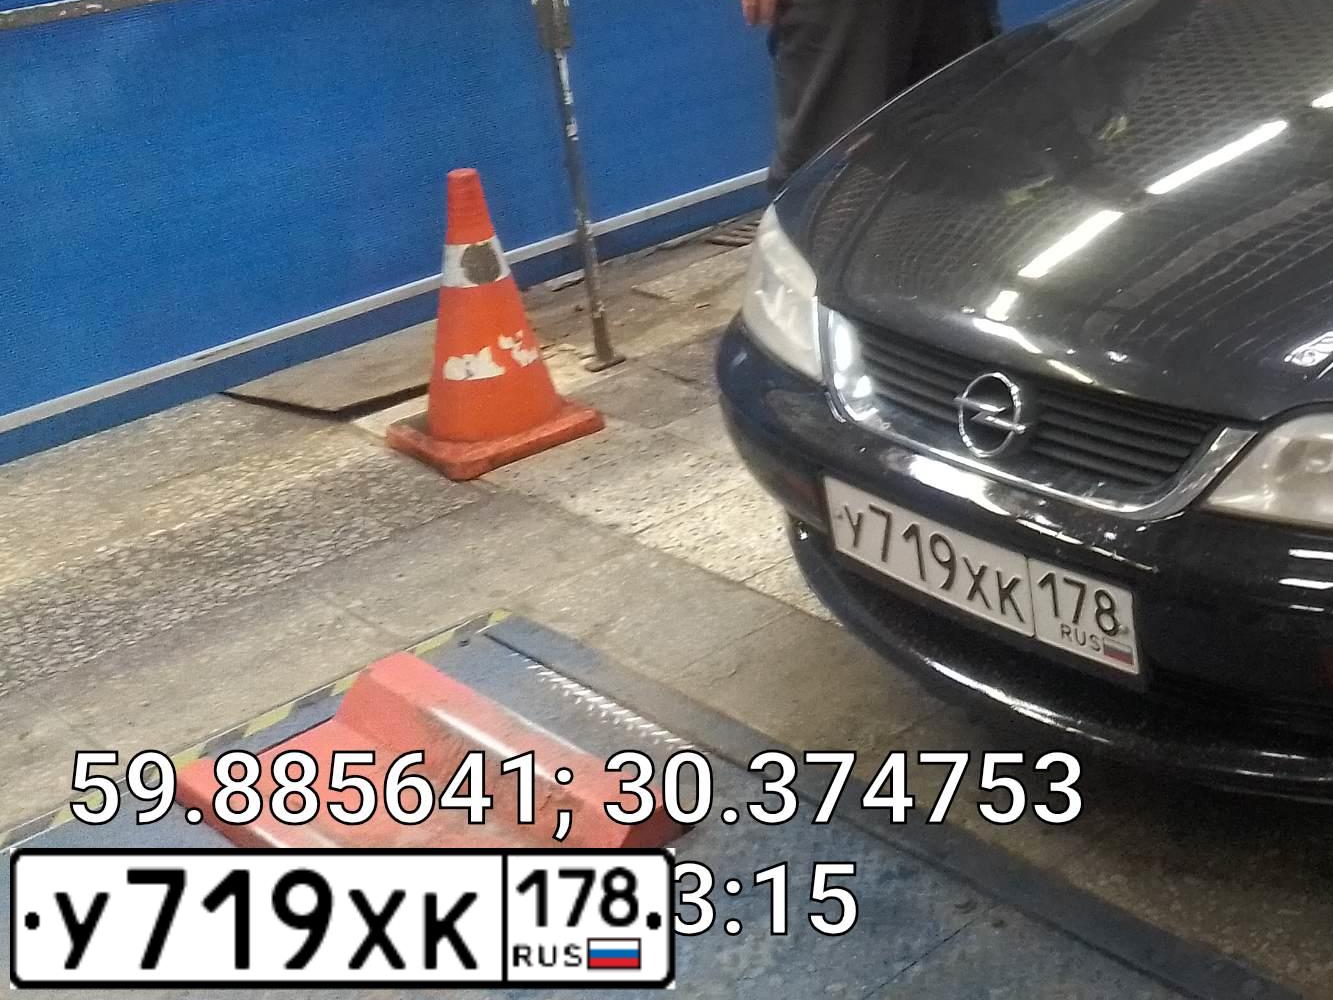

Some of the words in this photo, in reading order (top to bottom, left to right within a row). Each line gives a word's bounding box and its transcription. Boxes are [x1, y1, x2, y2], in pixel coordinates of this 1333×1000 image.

[844, 501, 1025, 624] У719ХК
[1036, 570, 1121, 638] 178
[1060, 622, 1102, 652] RUS
